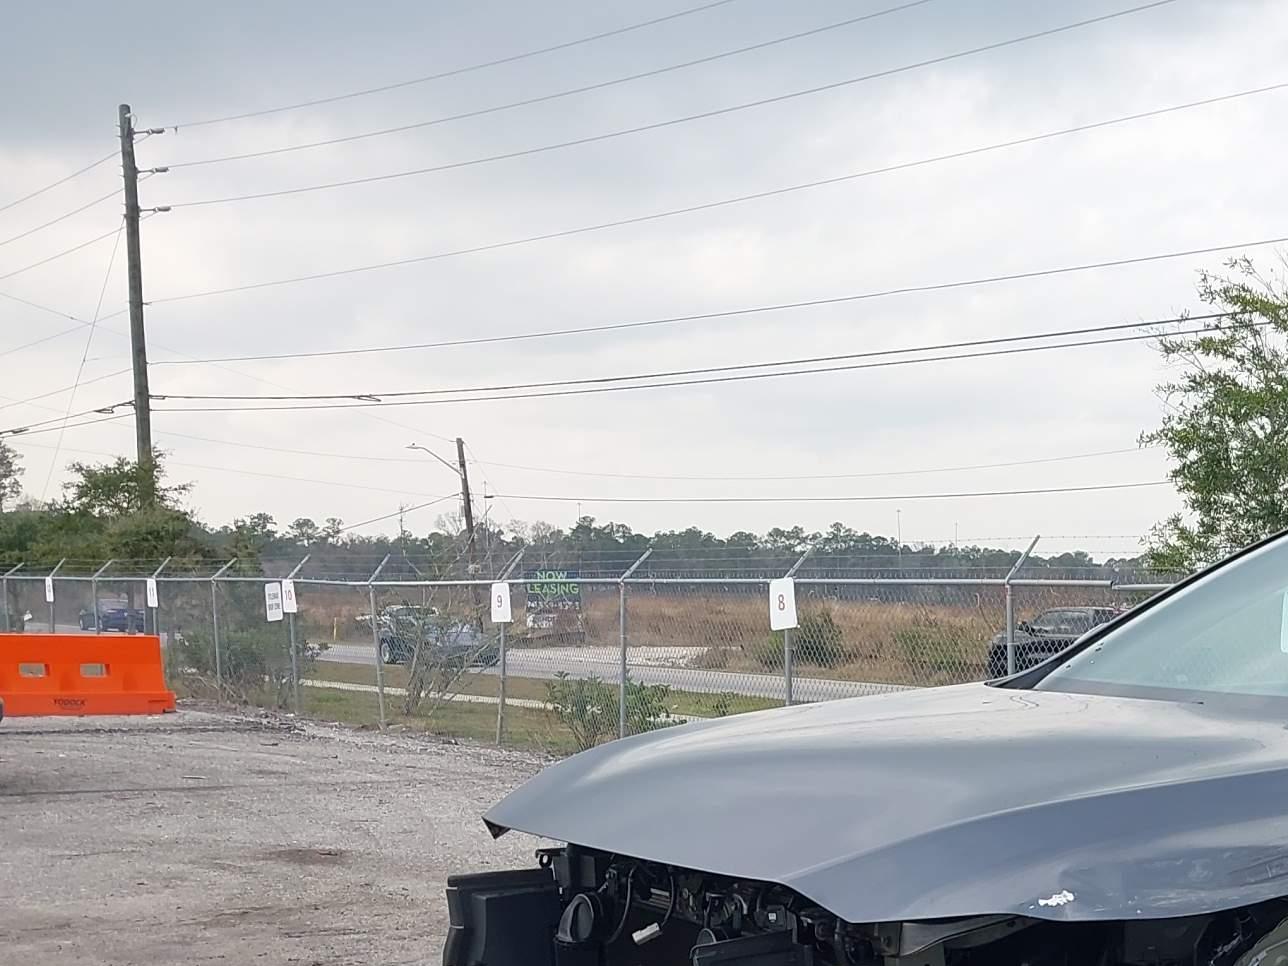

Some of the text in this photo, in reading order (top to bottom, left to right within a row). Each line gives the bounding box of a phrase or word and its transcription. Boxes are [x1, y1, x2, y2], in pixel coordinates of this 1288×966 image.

[536, 570, 567, 581] NOW
[527, 583, 579, 594] LEASING
[284, 590, 293, 601] 10
[496, 594, 503, 609] 9
[778, 593, 786, 611] 8
